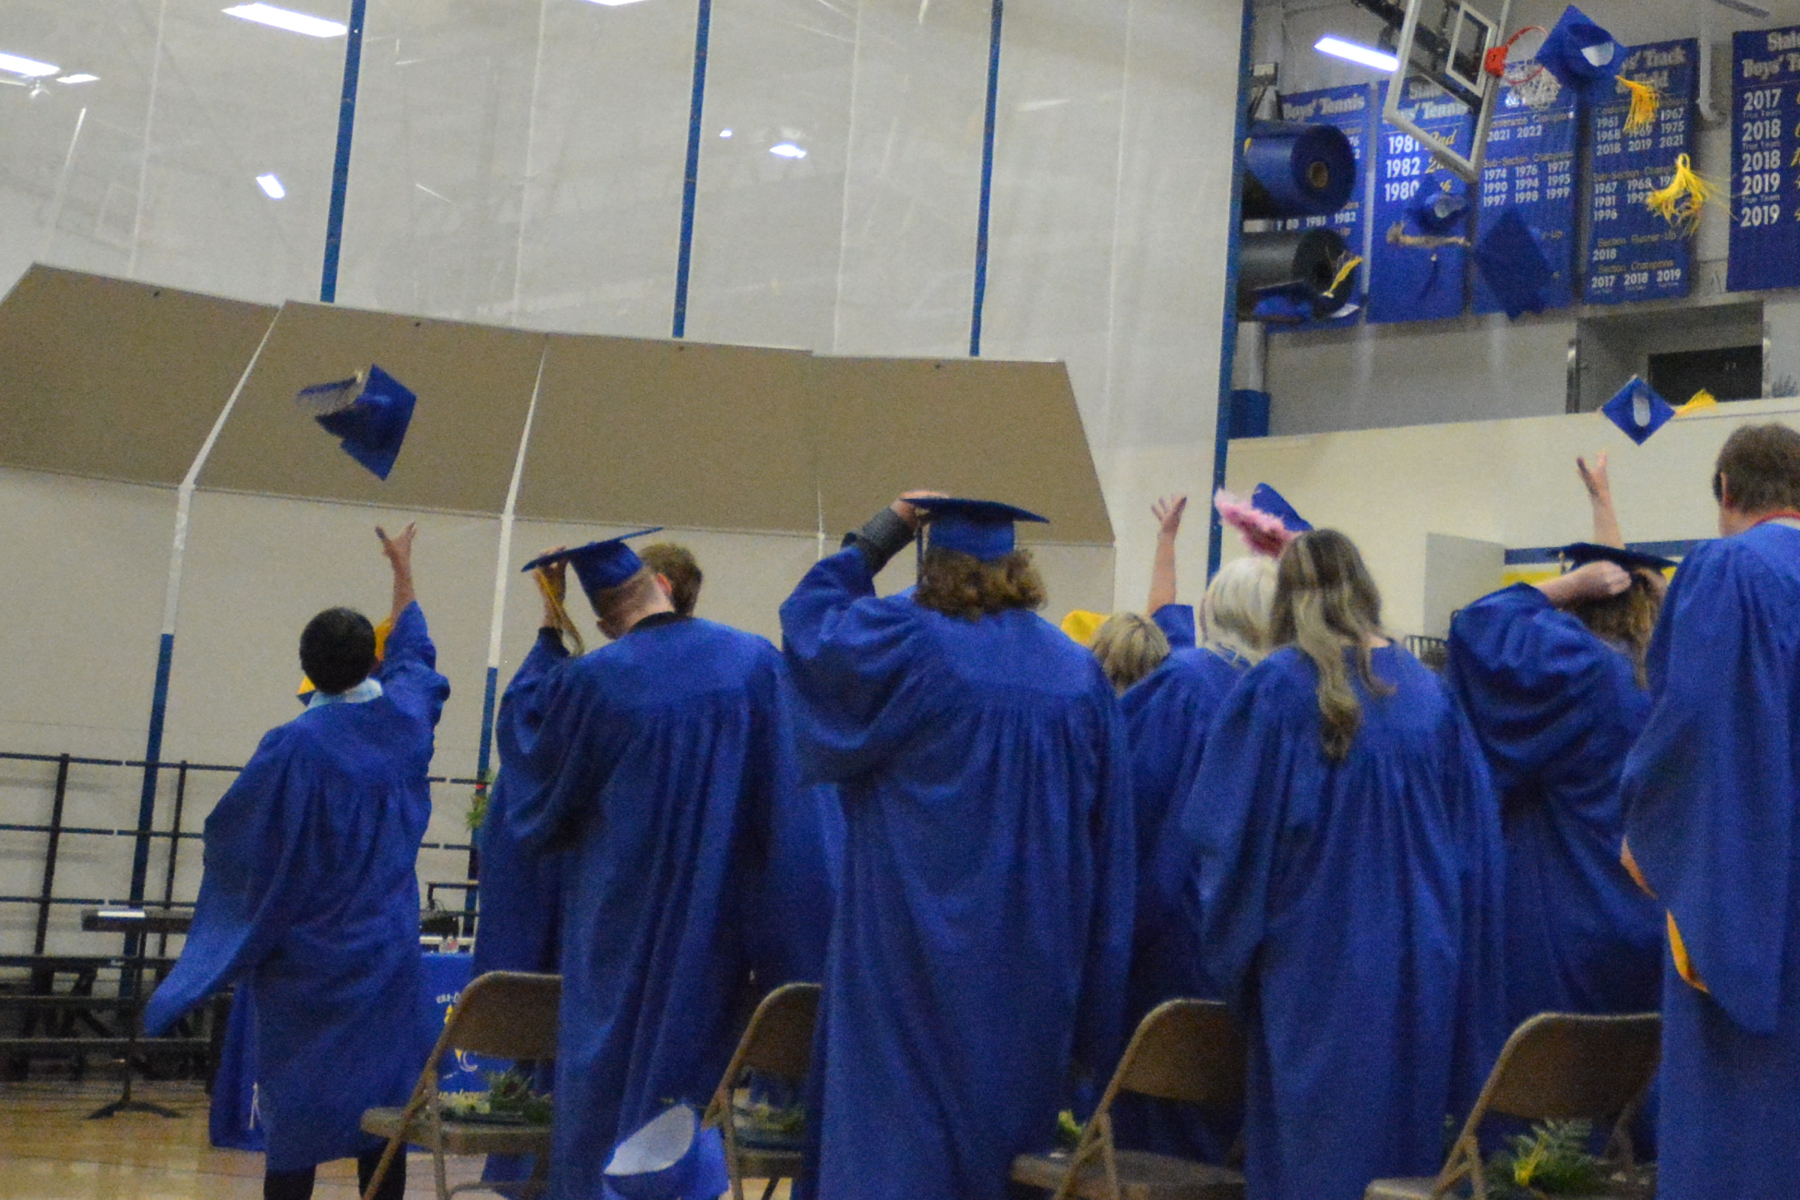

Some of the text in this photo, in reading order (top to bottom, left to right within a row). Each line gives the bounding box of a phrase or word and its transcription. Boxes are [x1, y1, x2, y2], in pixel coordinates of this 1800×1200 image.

[1742, 54, 1784, 80] Boys'
[1743, 88, 1782, 111] 2017
[1516, 125, 1542, 138] 2022
[1742, 118, 1781, 141] 2018
[1389, 135, 1420, 154] 1981
[1386, 157, 1421, 179] 1982
[1741, 149, 1781, 173] 2018
[1741, 172, 1781, 195] 2019
[1740, 204, 1780, 227] 2019
[1592, 275, 1615, 289] 2017
[1624, 272, 1648, 286] 2018
[1657, 269, 1681, 283] 2019
